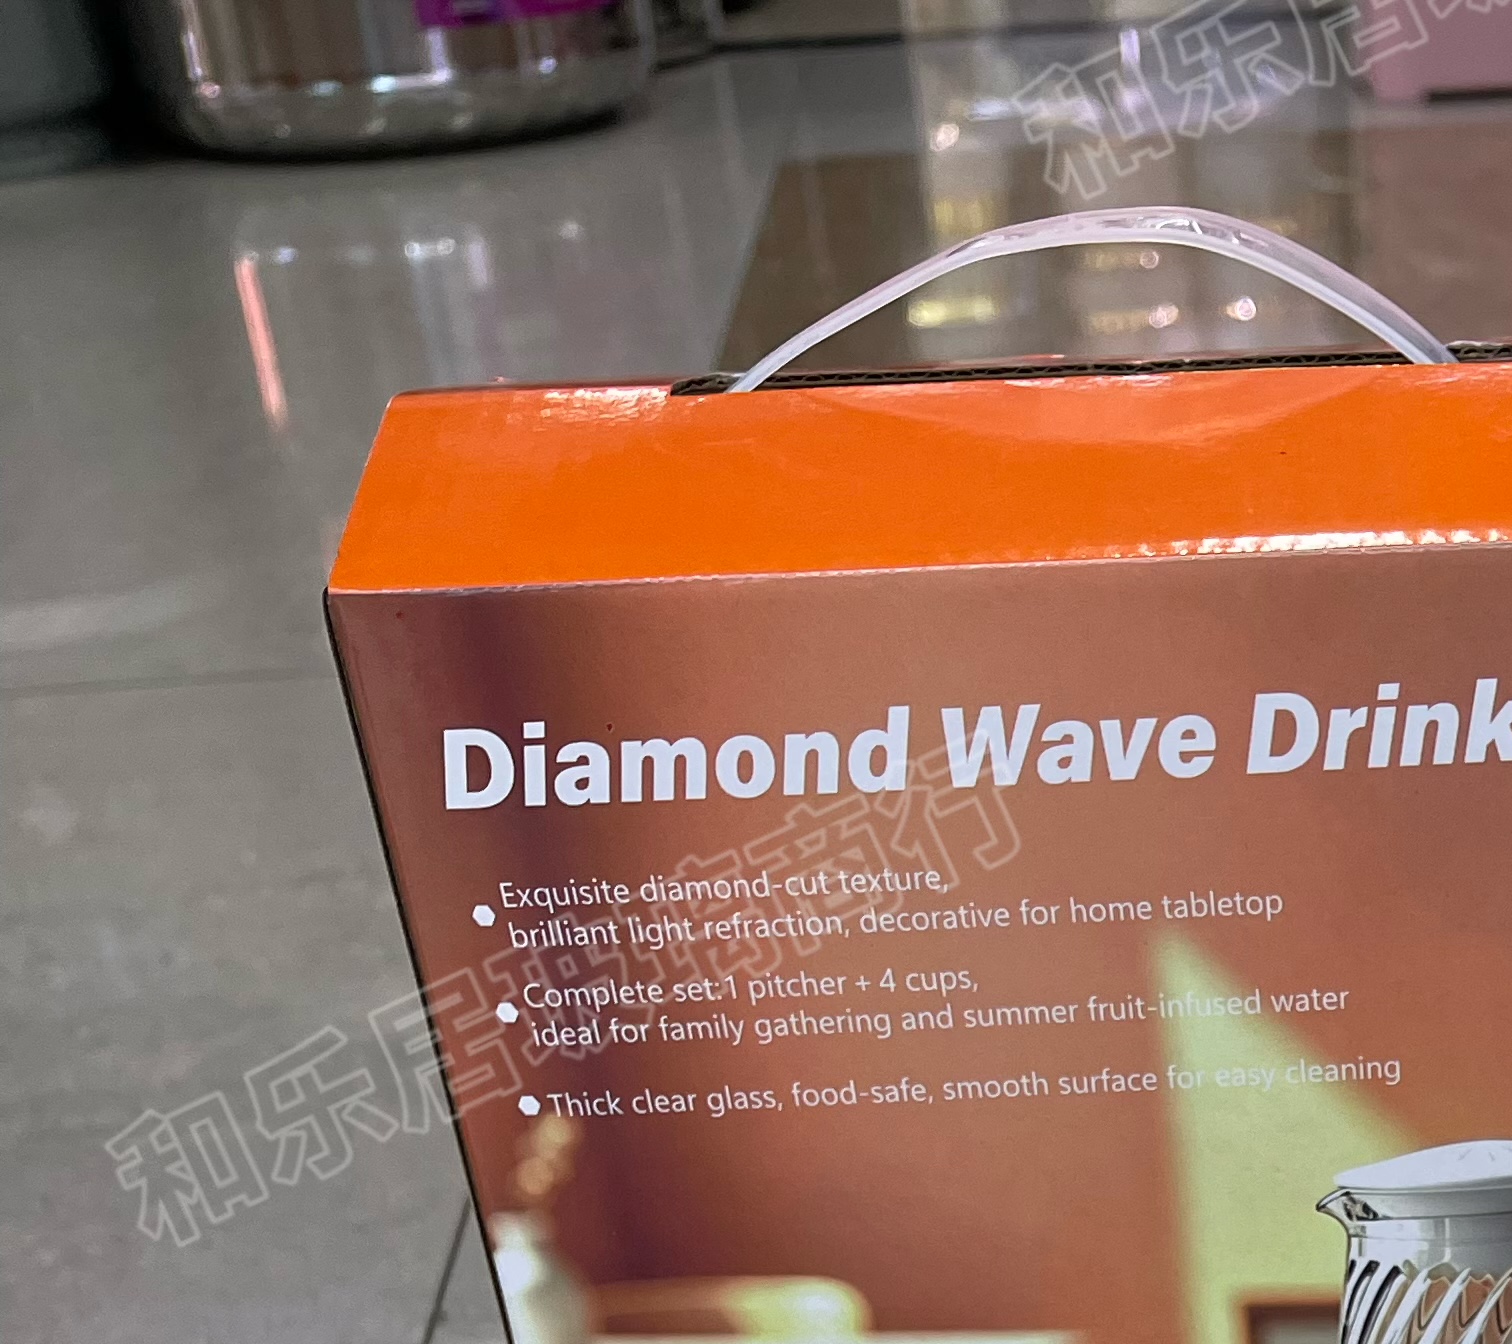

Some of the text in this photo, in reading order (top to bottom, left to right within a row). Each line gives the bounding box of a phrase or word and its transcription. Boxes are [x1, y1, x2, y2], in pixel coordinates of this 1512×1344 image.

[443, 705, 910, 810] Diamond
[941, 703, 1217, 788] Wave
[500, 869, 949, 913] Exquisite diamond-cut texture,
[509, 890, 1284, 950] brilliant light refraction, decorative for home tabletop
[523, 979, 664, 1011] Complete
[748, 972, 847, 1005] pitcher
[880, 967, 896, 993] 4
[905, 969, 979, 997] cups,
[530, 987, 1350, 1048] ideal for family gathering and summer fruit-infused water
[546, 1055, 1401, 1119] Thick clear glass, food-safe, smooth surface for easy cleaning
